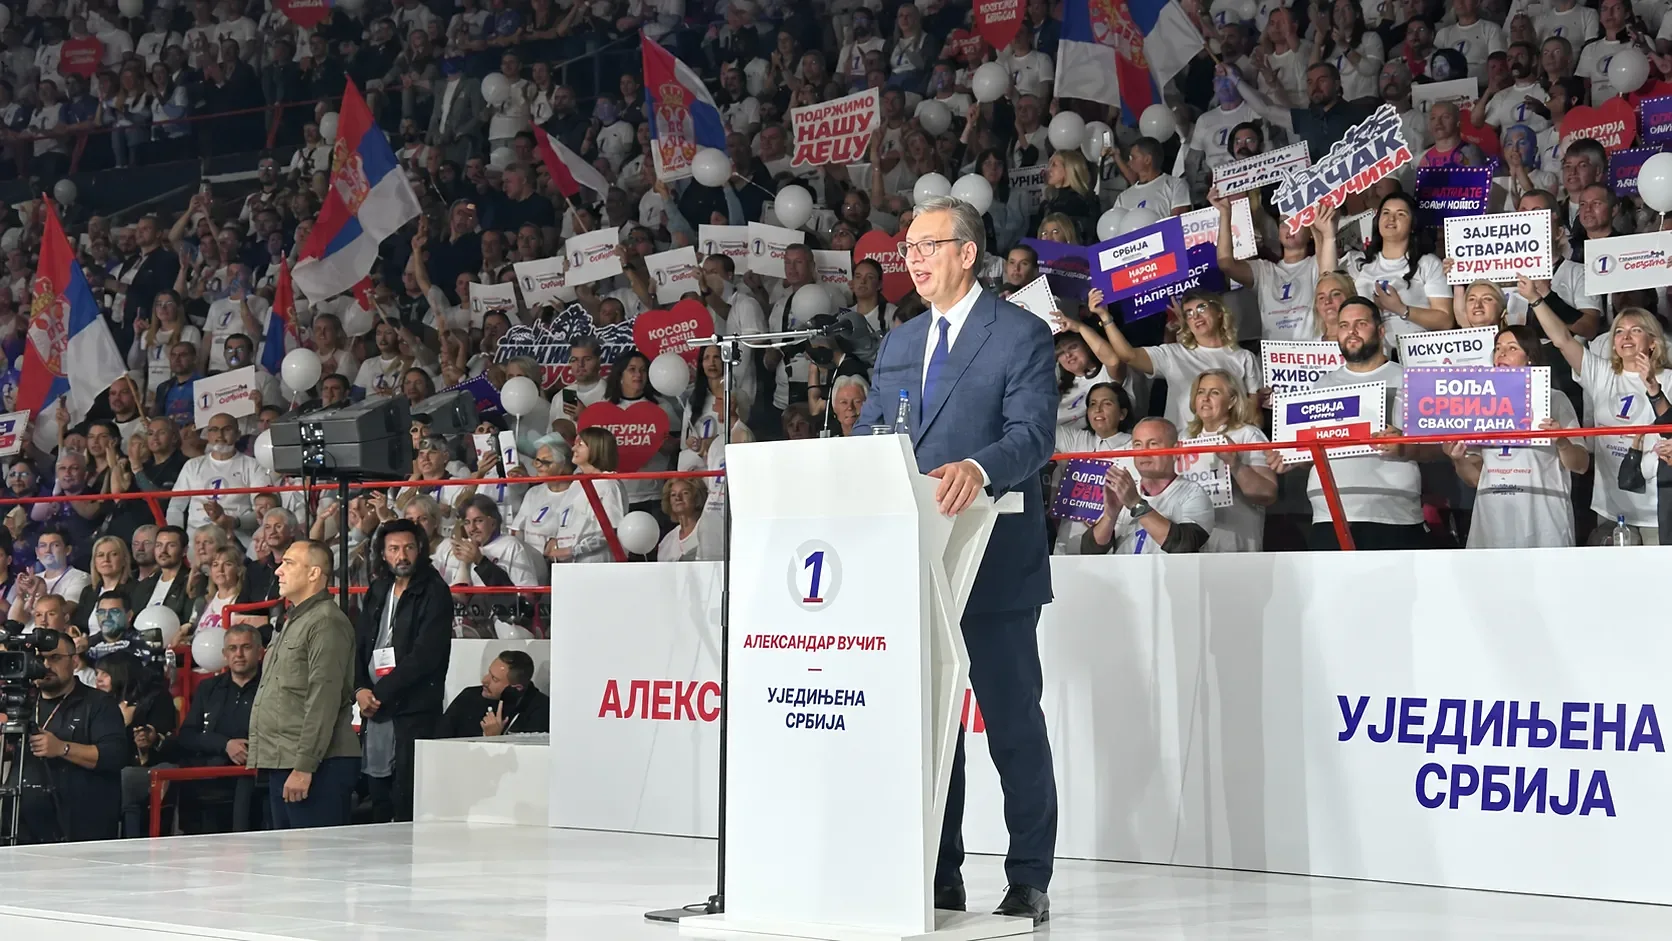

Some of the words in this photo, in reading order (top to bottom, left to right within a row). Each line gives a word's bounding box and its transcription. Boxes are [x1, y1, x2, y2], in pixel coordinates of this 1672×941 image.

[795, 96, 875, 125] ПОДРЖИМО
[798, 110, 874, 142] НАШУ
[792, 131, 872, 165] ДЕЦУ
[1280, 125, 1404, 213] ЧАЧАК
[1287, 209, 1316, 233] УЗ
[1463, 223, 1532, 240] ЗАЈЕДНО
[1112, 241, 1149, 259] СРБИЈА
[1455, 240, 1540, 258] СТВАРАМО
[1128, 263, 1158, 279] НАРОД
[1457, 256, 1543, 273] БУДУЋНОСТ
[1599, 256, 1608, 273] 1
[1134, 277, 1201, 307] НАПРЕДАК
[1280, 283, 1292, 300] 1
[648, 318, 699, 341] КОСОВО
[1407, 339, 1484, 357] ИСКУСТВО
[1435, 379, 1497, 397] БОЉА
[201, 394, 209, 409] 1
[1300, 401, 1345, 416] СРБИЈА
[1418, 396, 1514, 417] СРБИЈА
[1616, 395, 1635, 419] 1
[1316, 427, 1350, 440] НАРОД
[1418, 418, 1472, 430] СВАКОГ
[1474, 418, 1515, 432] ДАНА
[505, 448, 515, 464] 1
[532, 507, 549, 523] 1
[802, 551, 825, 603] 1
[743, 634, 836, 652] АЛЕКСАНДАР
[837, 635, 887, 651] ВУЧИЋ
[598, 679, 721, 722] АЛЕКС
[767, 686, 866, 707] УЈЕДИЊЕНА
[785, 712, 846, 731] СРБИЈА
[1337, 695, 1666, 755] УЈЕДИЊЕНА
[1415, 762, 1617, 817] СРБИЈА
